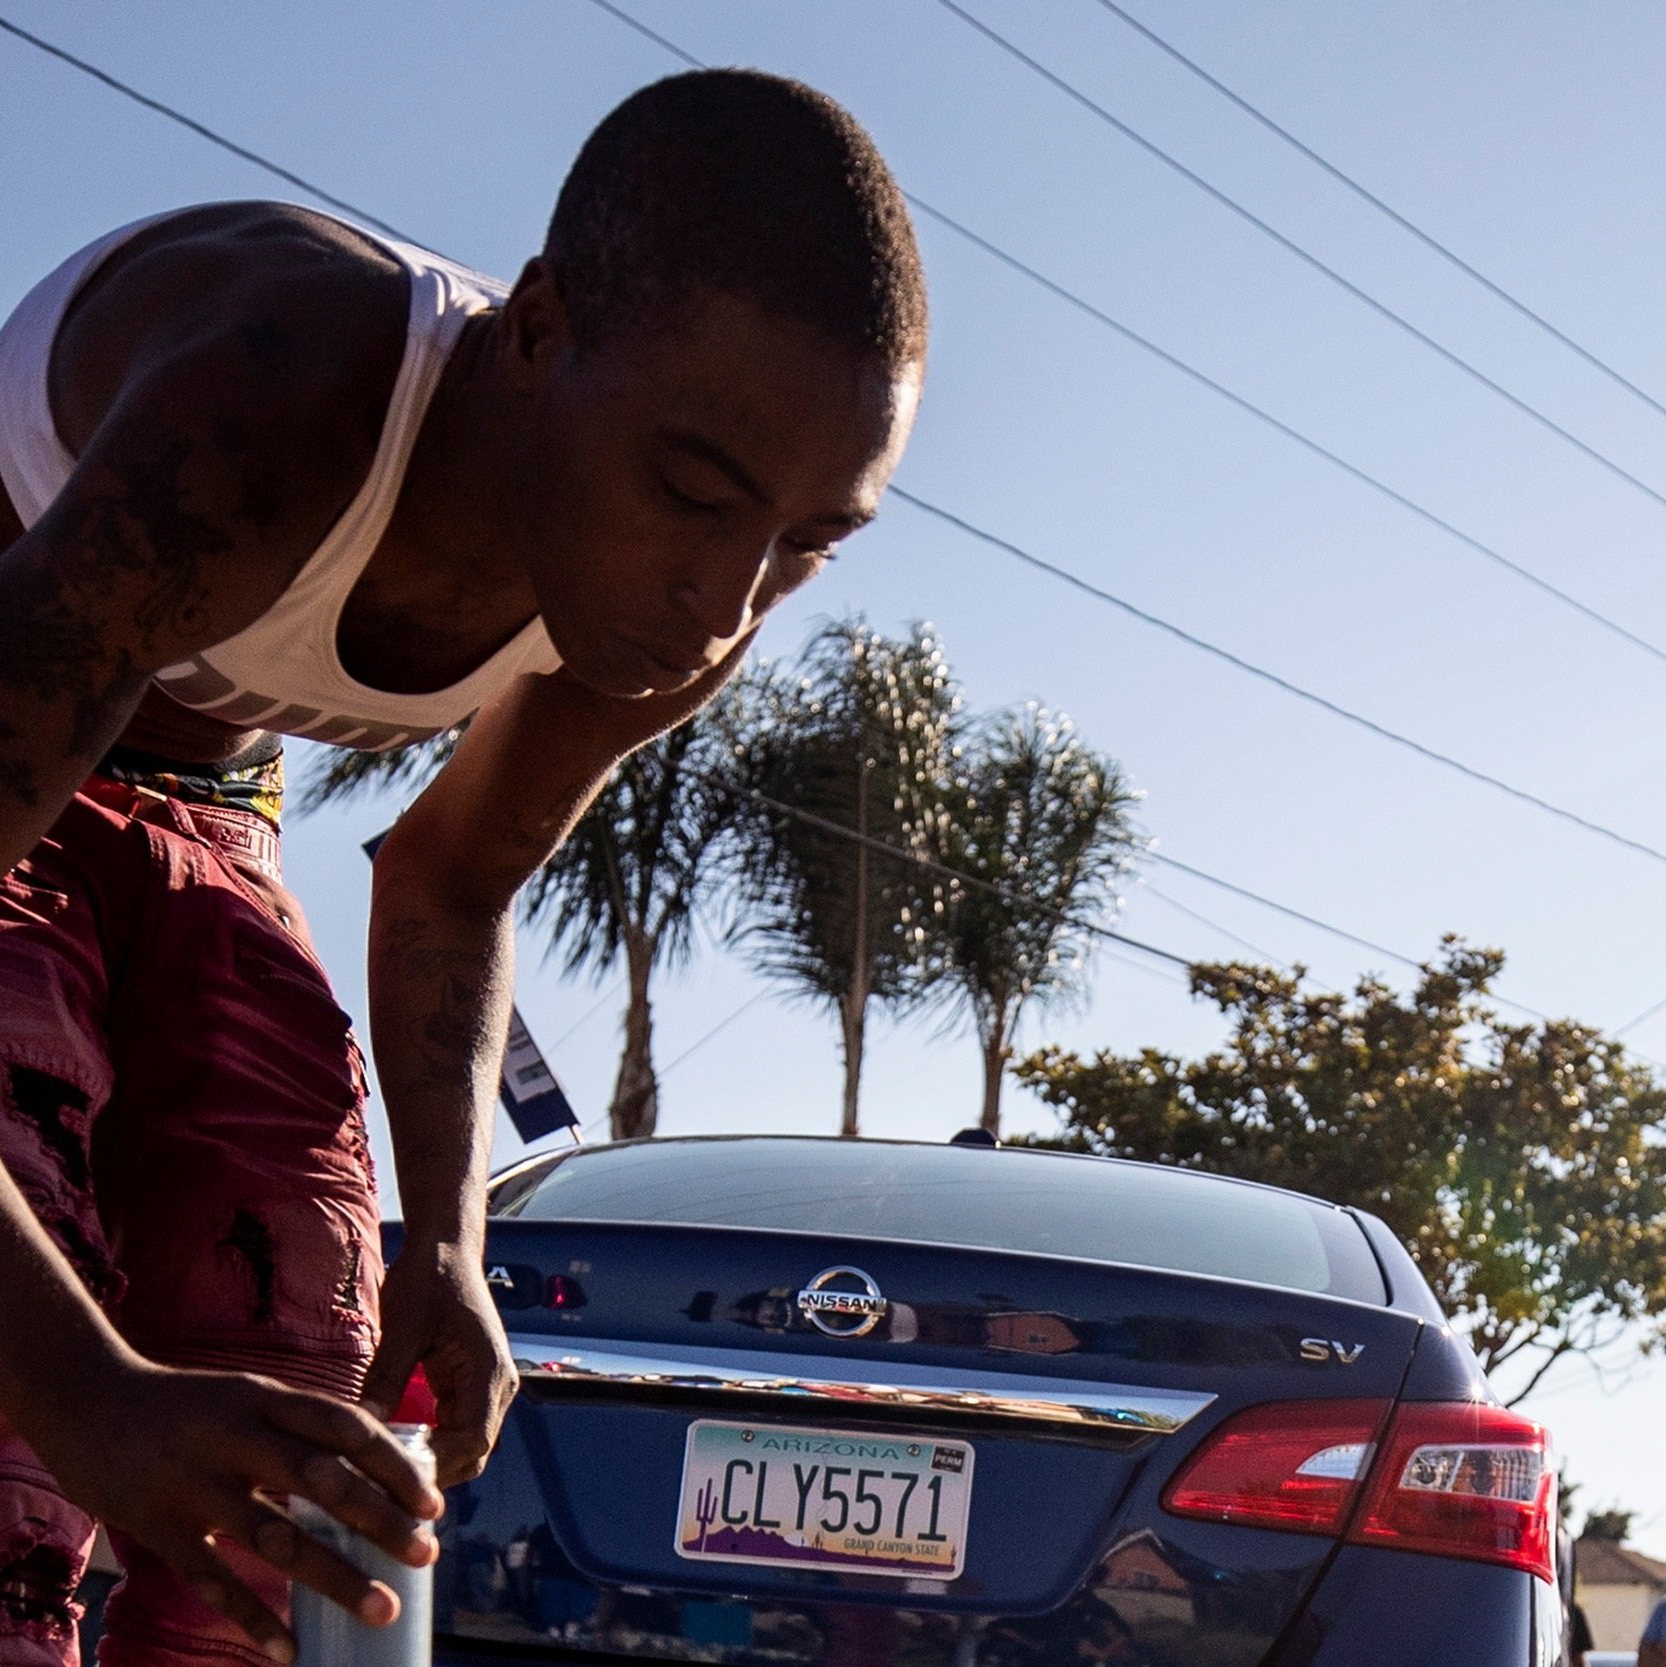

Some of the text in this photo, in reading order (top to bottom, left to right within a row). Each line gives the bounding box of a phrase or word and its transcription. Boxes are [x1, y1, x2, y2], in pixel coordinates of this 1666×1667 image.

[806, 1293, 877, 1310] NISSAN
[1300, 1337, 1366, 1364] SV
[761, 1436, 900, 1460] ARIZONA
[934, 1453, 963, 1466] PERM
[720, 1458, 948, 1543] CLY5571
[843, 1537, 940, 1557] GRAND CANYON STATE
